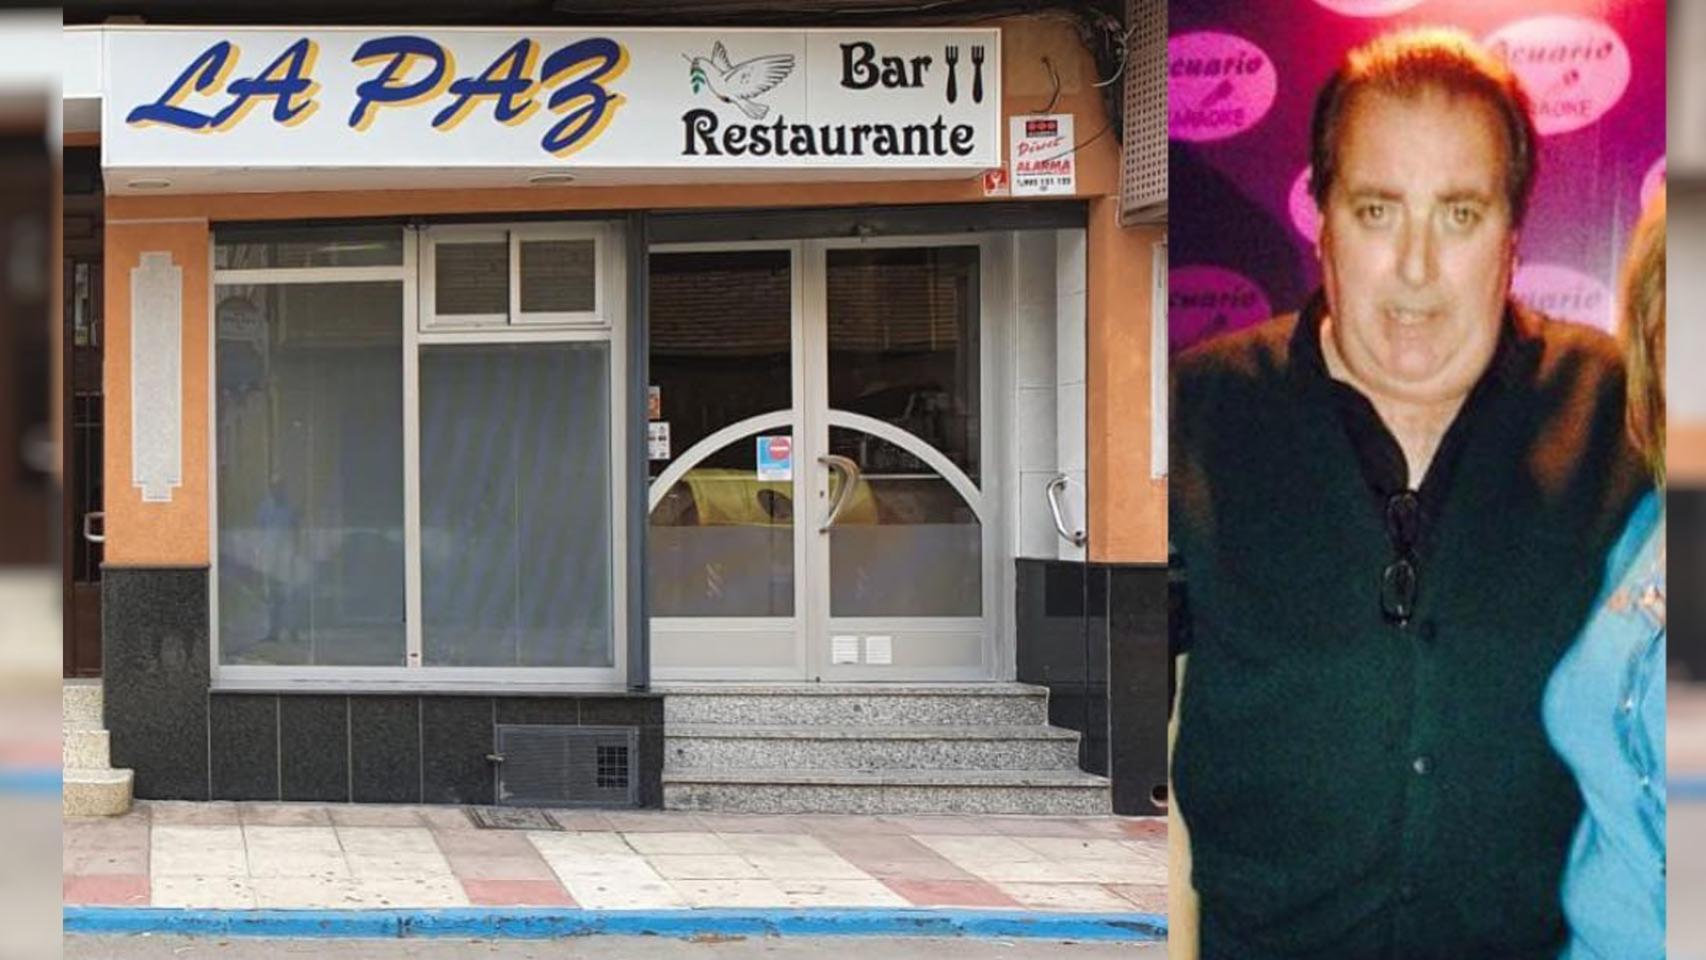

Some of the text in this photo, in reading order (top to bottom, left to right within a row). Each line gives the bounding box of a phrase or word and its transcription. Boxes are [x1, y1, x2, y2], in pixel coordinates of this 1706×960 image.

[840, 41, 932, 90] Bar
[126, 35, 631, 157] LA PAZ
[681, 108, 975, 156] Restaurante
